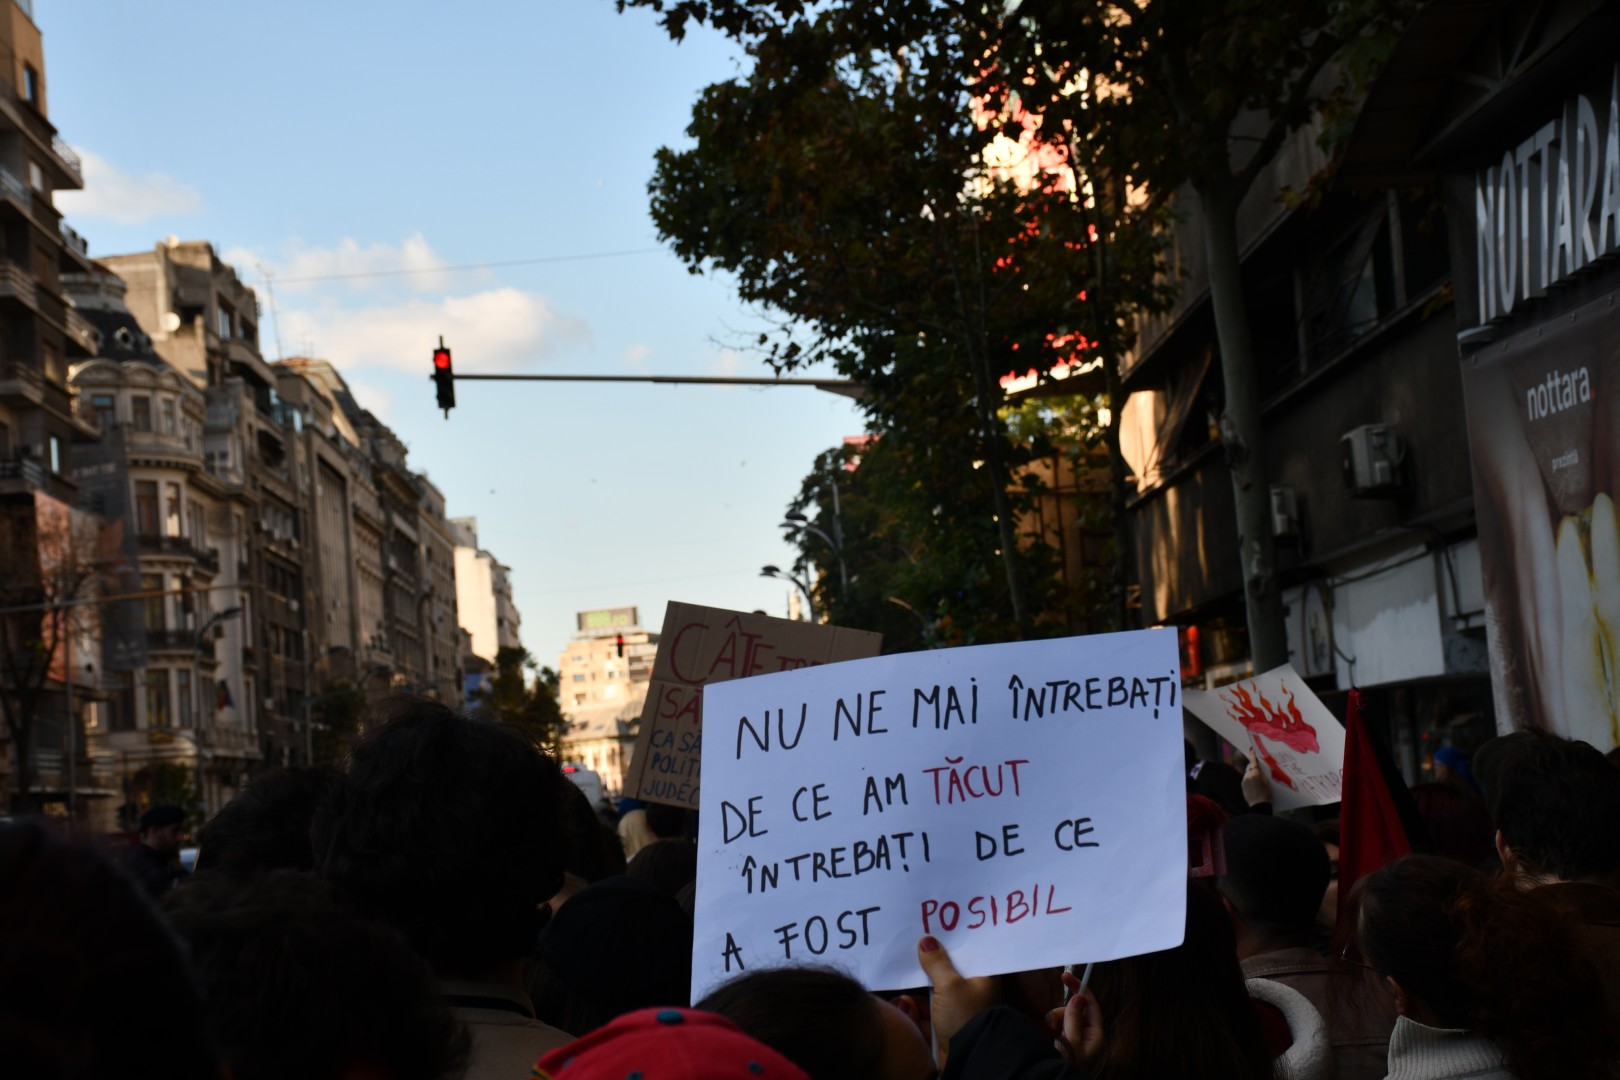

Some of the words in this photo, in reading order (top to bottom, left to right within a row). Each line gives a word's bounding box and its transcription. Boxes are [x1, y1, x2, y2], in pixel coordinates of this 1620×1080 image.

[1475, 60, 1620, 326] NOTTARA
[736, 703, 807, 760] NU
[834, 690, 888, 742] NE
[912, 677, 978, 731] MAI
[720, 796, 769, 845] DE
[792, 784, 833, 822] CE
[862, 773, 909, 816] AM
[922, 756, 1030, 806] TĂCUT
[740, 832, 930, 895] ÎNTREBAȚI
[975, 824, 1025, 862] DE
[1054, 817, 1100, 851] CE
[720, 932, 746, 973] A
[773, 907, 881, 960] FOST
[921, 884, 1072, 935] POSIBIL
